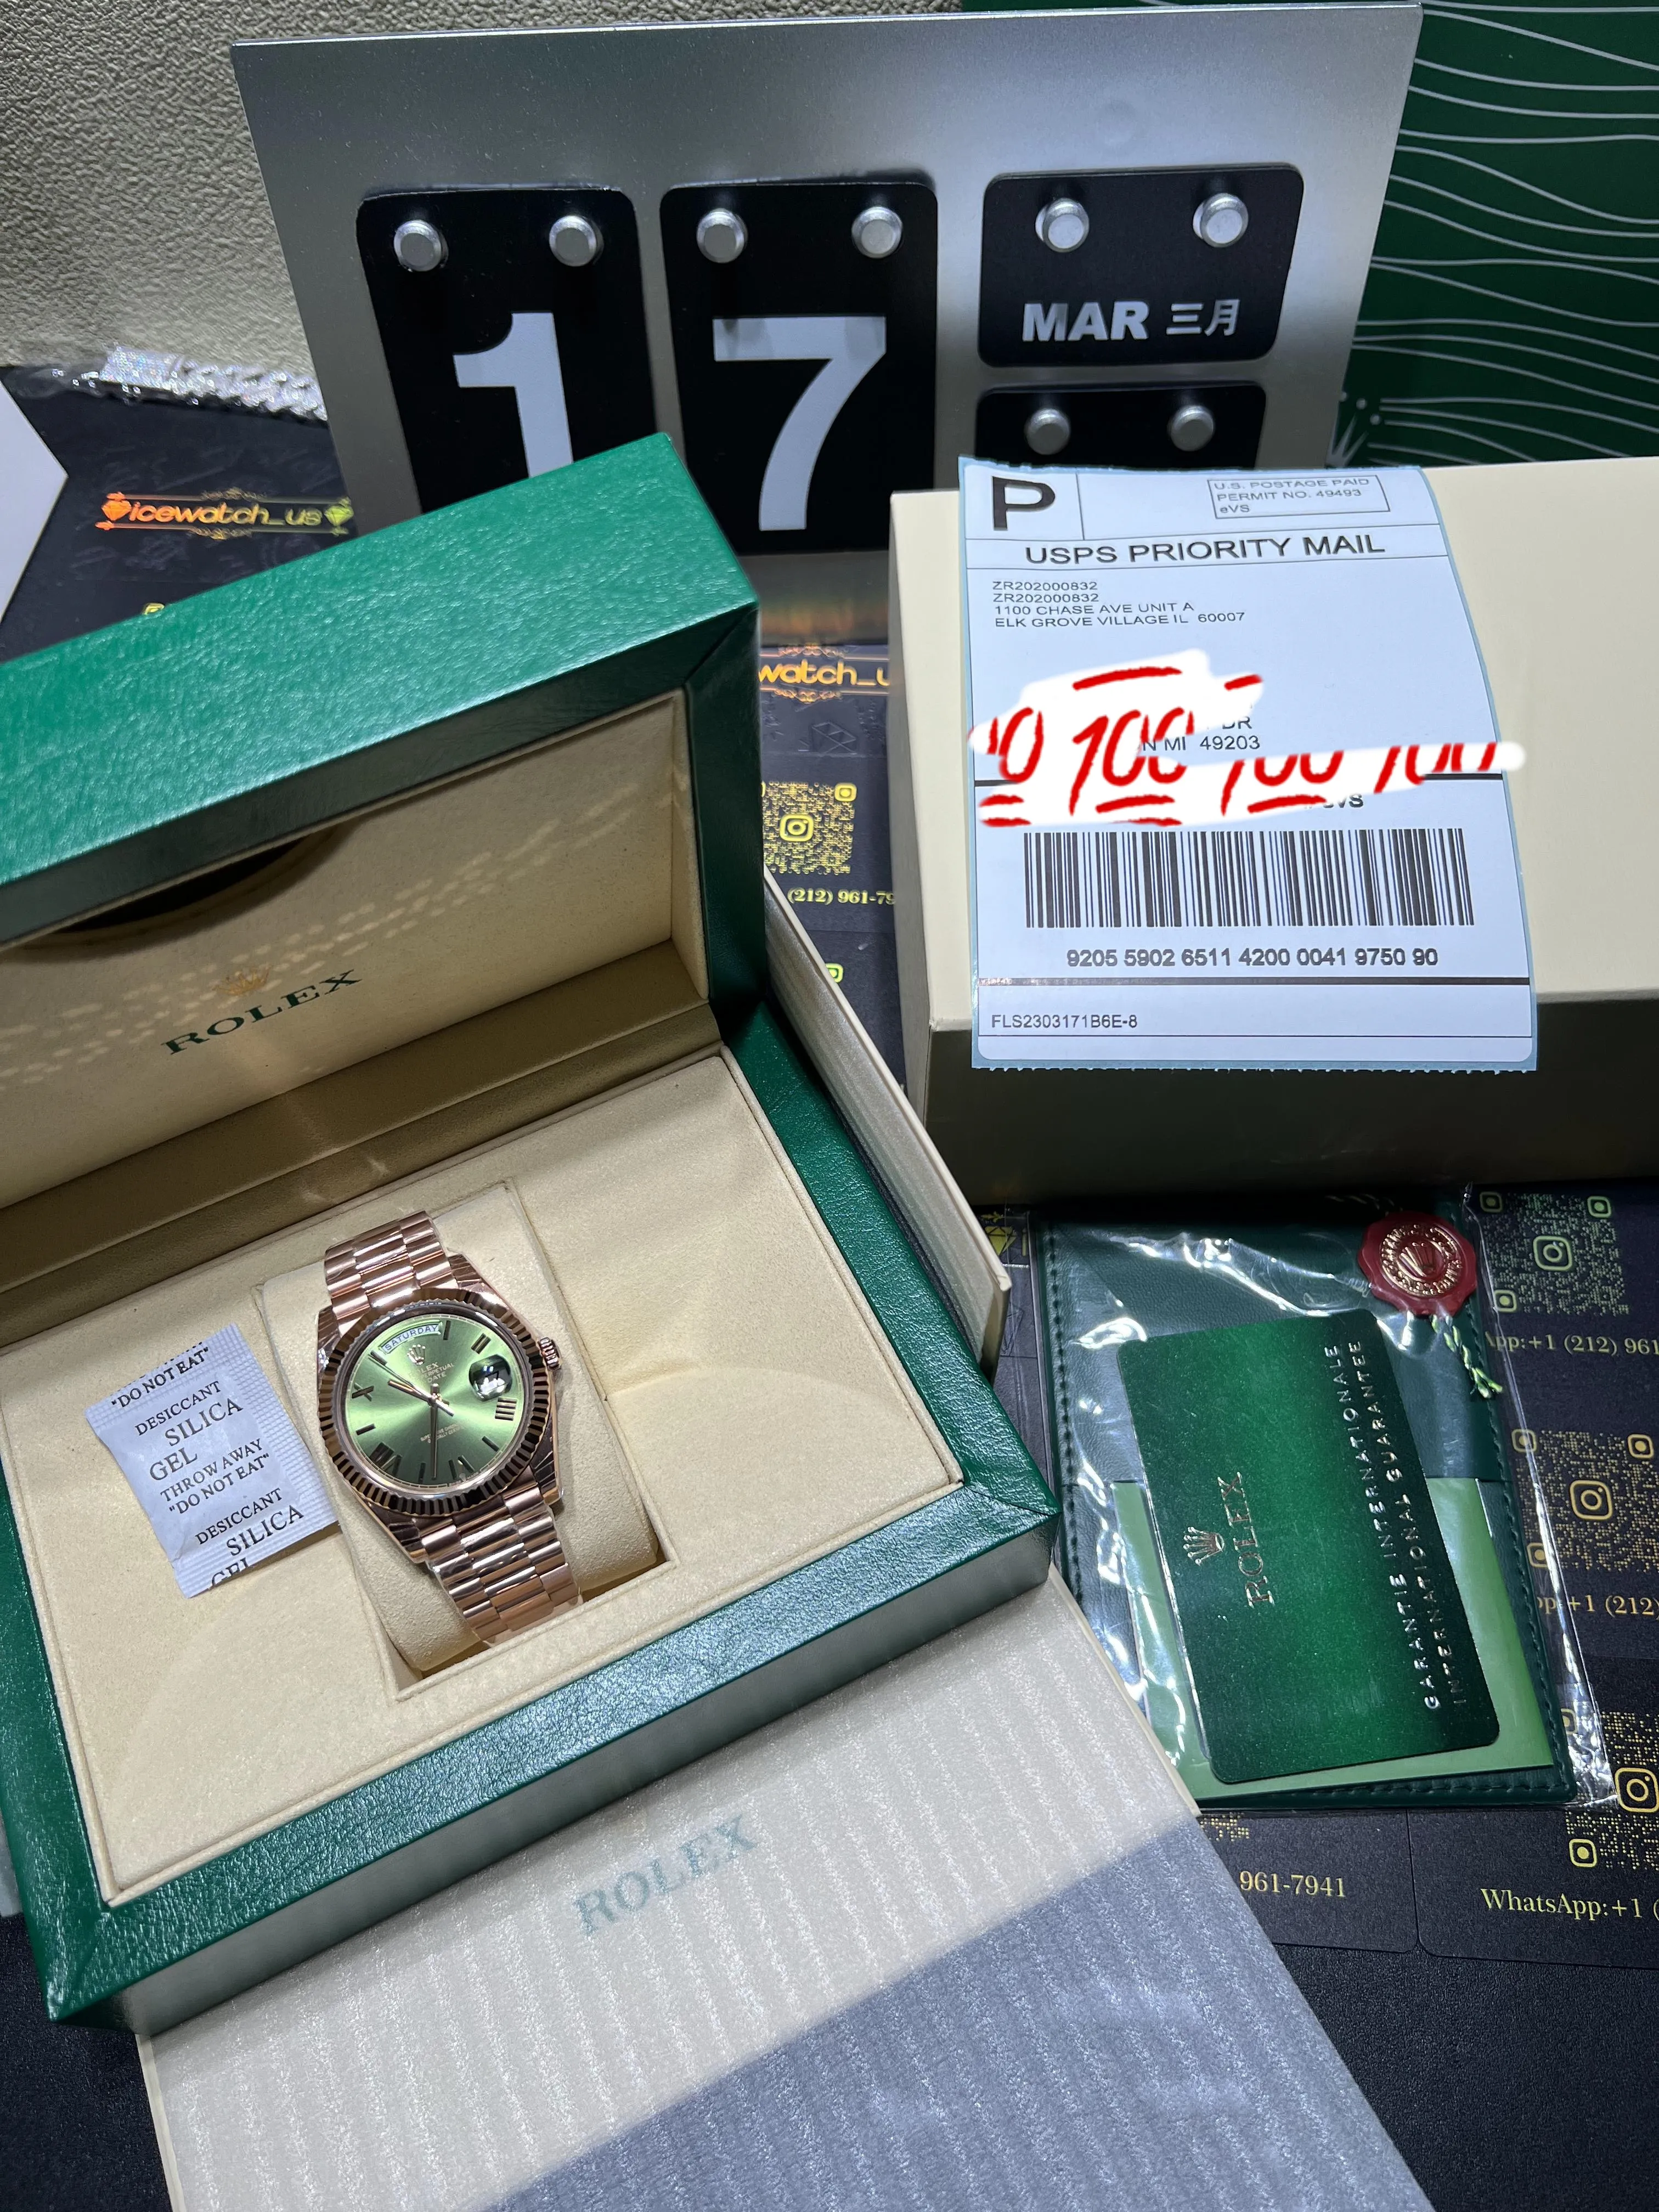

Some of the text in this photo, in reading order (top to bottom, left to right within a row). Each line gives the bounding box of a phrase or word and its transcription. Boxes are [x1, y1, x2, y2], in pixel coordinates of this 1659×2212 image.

[1022, 301, 1150, 342] MAR
[1166, 299, 1240, 336] 三月
[453, 312, 887, 531] 1 7
[1214, 478, 1370, 490] U.S. POSTAGE PAID
[1217, 489, 1362, 501] PERMIT NO. 49493
[128, 501, 322, 527] icewatch_us
[992, 476, 1056, 531] P
[1220, 504, 1250, 514] eVS
[1025, 534, 1385, 565] USPS PRIORITY MAIL
[992, 581, 1098, 591] ZR202000832
[993, 593, 1099, 603] ZR202000832
[995, 602, 1194, 615] 1100 CHASE AVE UNIT A
[995, 612, 1245, 627] ELK GROVE VILLAGE IL 60007
[1164, 736, 1187, 751] MI
[1199, 735, 1260, 751] 49203
[787, 888, 833, 905] (212)
[1067, 947, 1438, 967] 9205 5902 6511 4200 0041 9750 90
[161, 969, 362, 1055] ROLEX
[991, 1014, 1137, 1028] FLS2303171B6E-8
[385, 1324, 438, 1351] SATURDAY
[1564, 1334, 1617, 1356] (212)
[142, 1368, 175, 1393] NOT
[134, 1381, 221, 1436] DESICCANT
[165, 1398, 243, 1446] SILICA
[1348, 1341, 1403, 1482] GUARANTEE
[150, 1447, 198, 1481] GEL
[160, 1438, 262, 1502] THROW AWAY
[169, 1453, 269, 1514] "DO NOT EAT"
[195, 1488, 282, 1544] DESICCANT
[227, 1505, 304, 1556] SILICA
[1324, 1346, 1442, 1709] GARANTIE INTERNATIONALE
[1217, 1472, 1275, 1609] ROLEX
[572, 1815, 756, 1936] ROLEX
[1239, 1870, 1346, 1897] 961-7941
